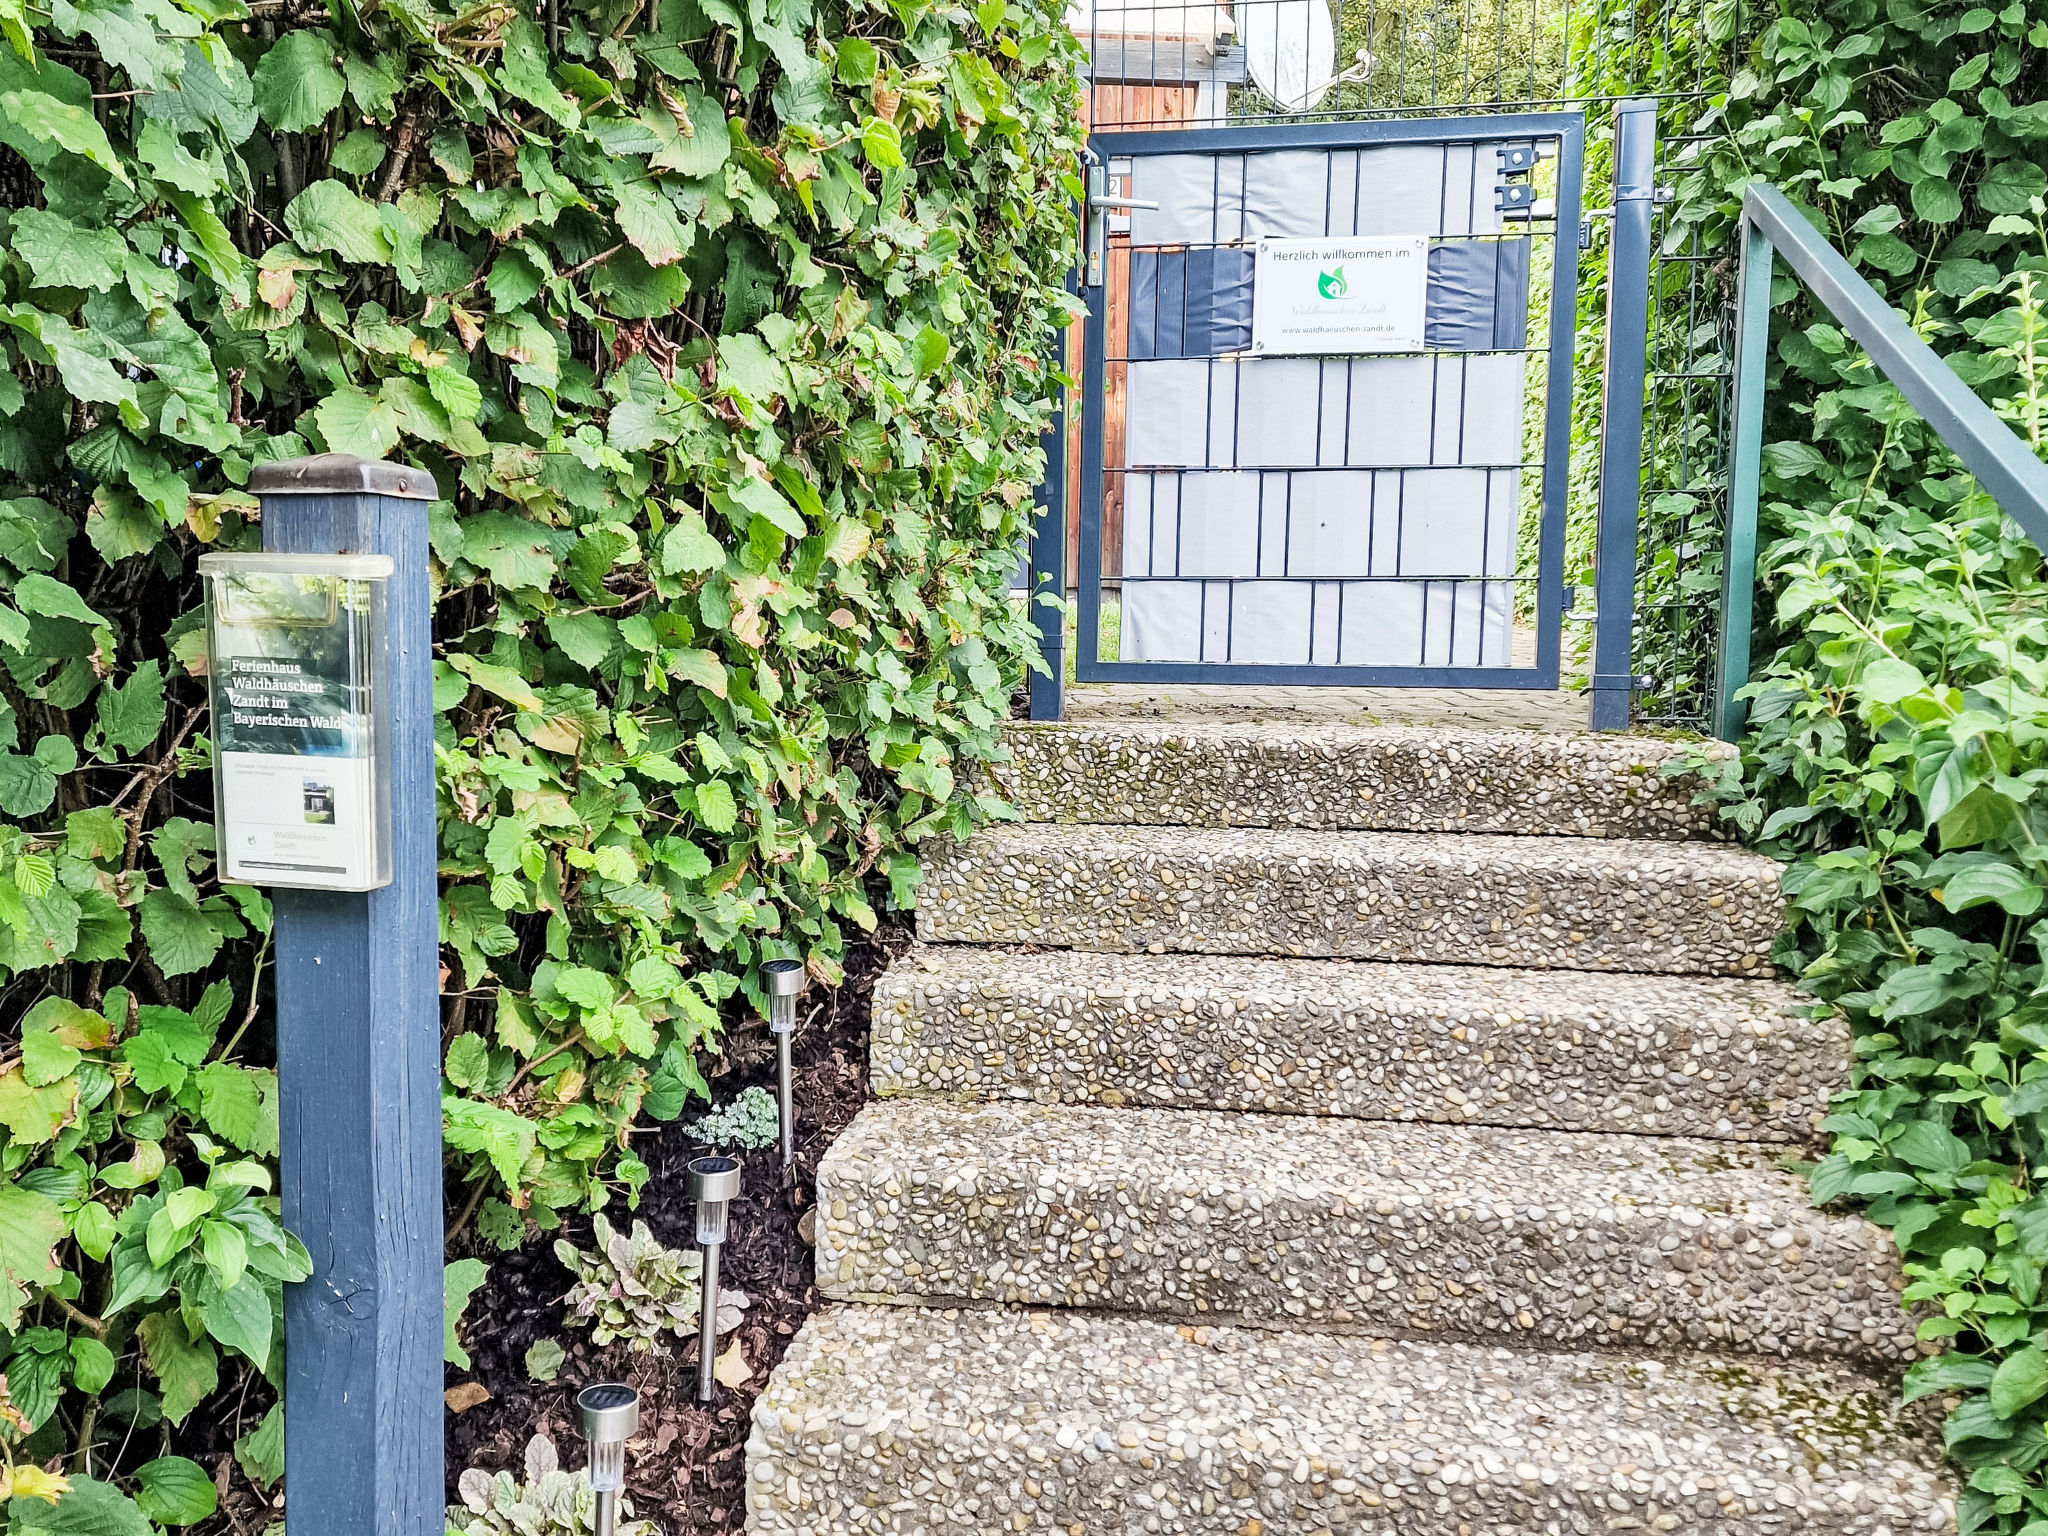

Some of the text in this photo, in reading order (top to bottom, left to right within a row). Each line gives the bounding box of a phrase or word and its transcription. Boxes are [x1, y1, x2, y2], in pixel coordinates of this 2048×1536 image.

[1273, 247, 1410, 261] Herzlich willkommen im
[1281, 324, 1395, 334] www.waldhaeuschen-zandt.de
[231, 659, 301, 674] Ferienhaus
[232, 676, 324, 693] Waldhäuschen
[232, 694, 289, 709] Zandt im
[233, 712, 342, 729] Bayerischen Wald
